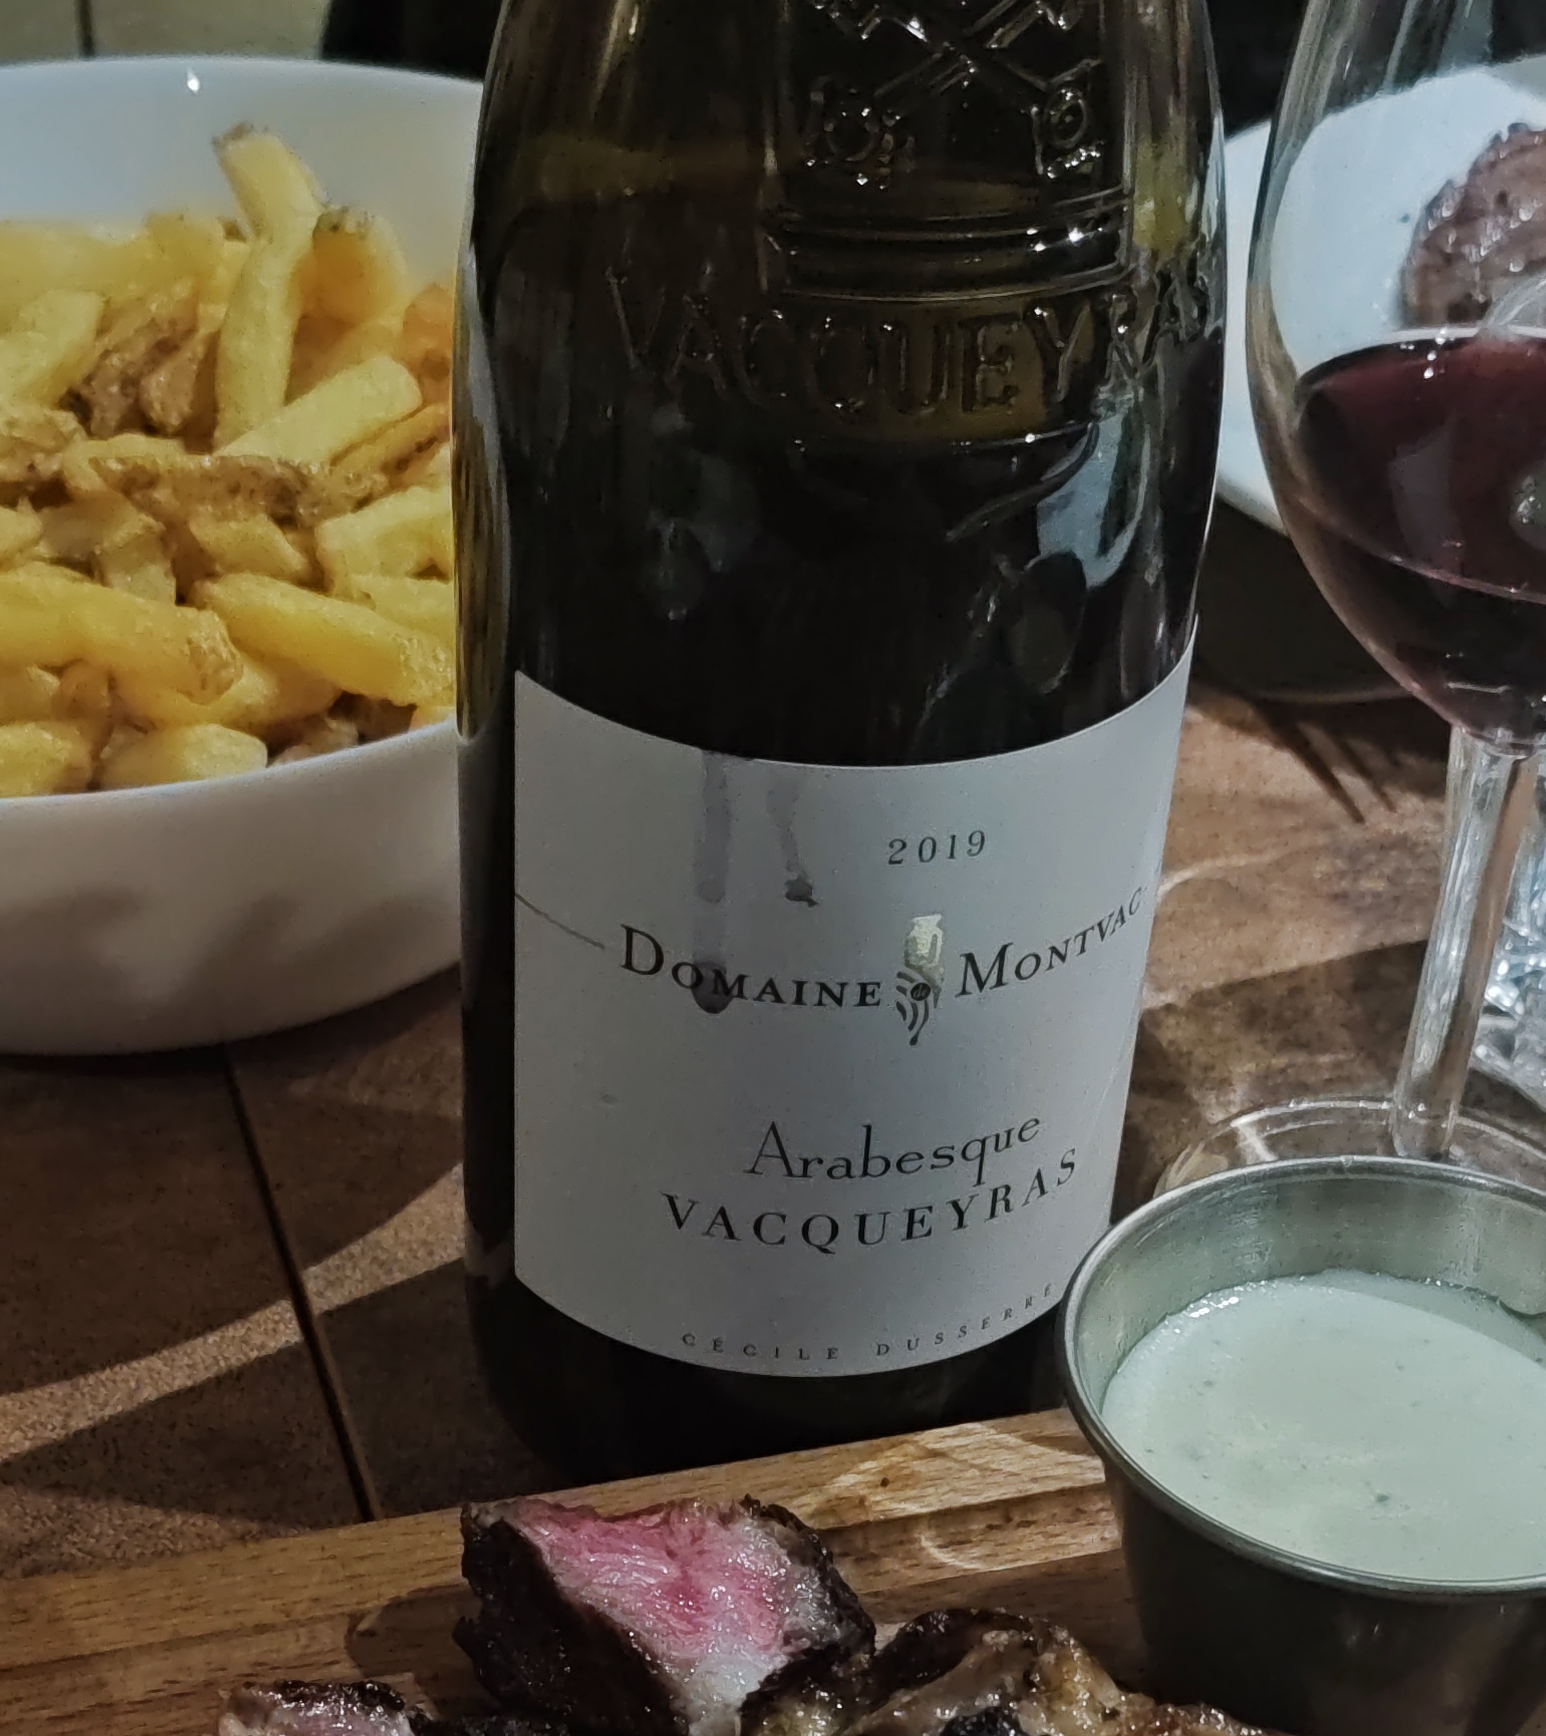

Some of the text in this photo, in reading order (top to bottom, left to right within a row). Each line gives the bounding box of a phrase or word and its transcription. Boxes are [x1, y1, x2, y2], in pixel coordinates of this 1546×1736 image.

[886, 830, 987, 866] 2019
[744, 1116, 1041, 1187] Arabesque
[661, 1147, 1078, 1256] VACQUEYRAS
